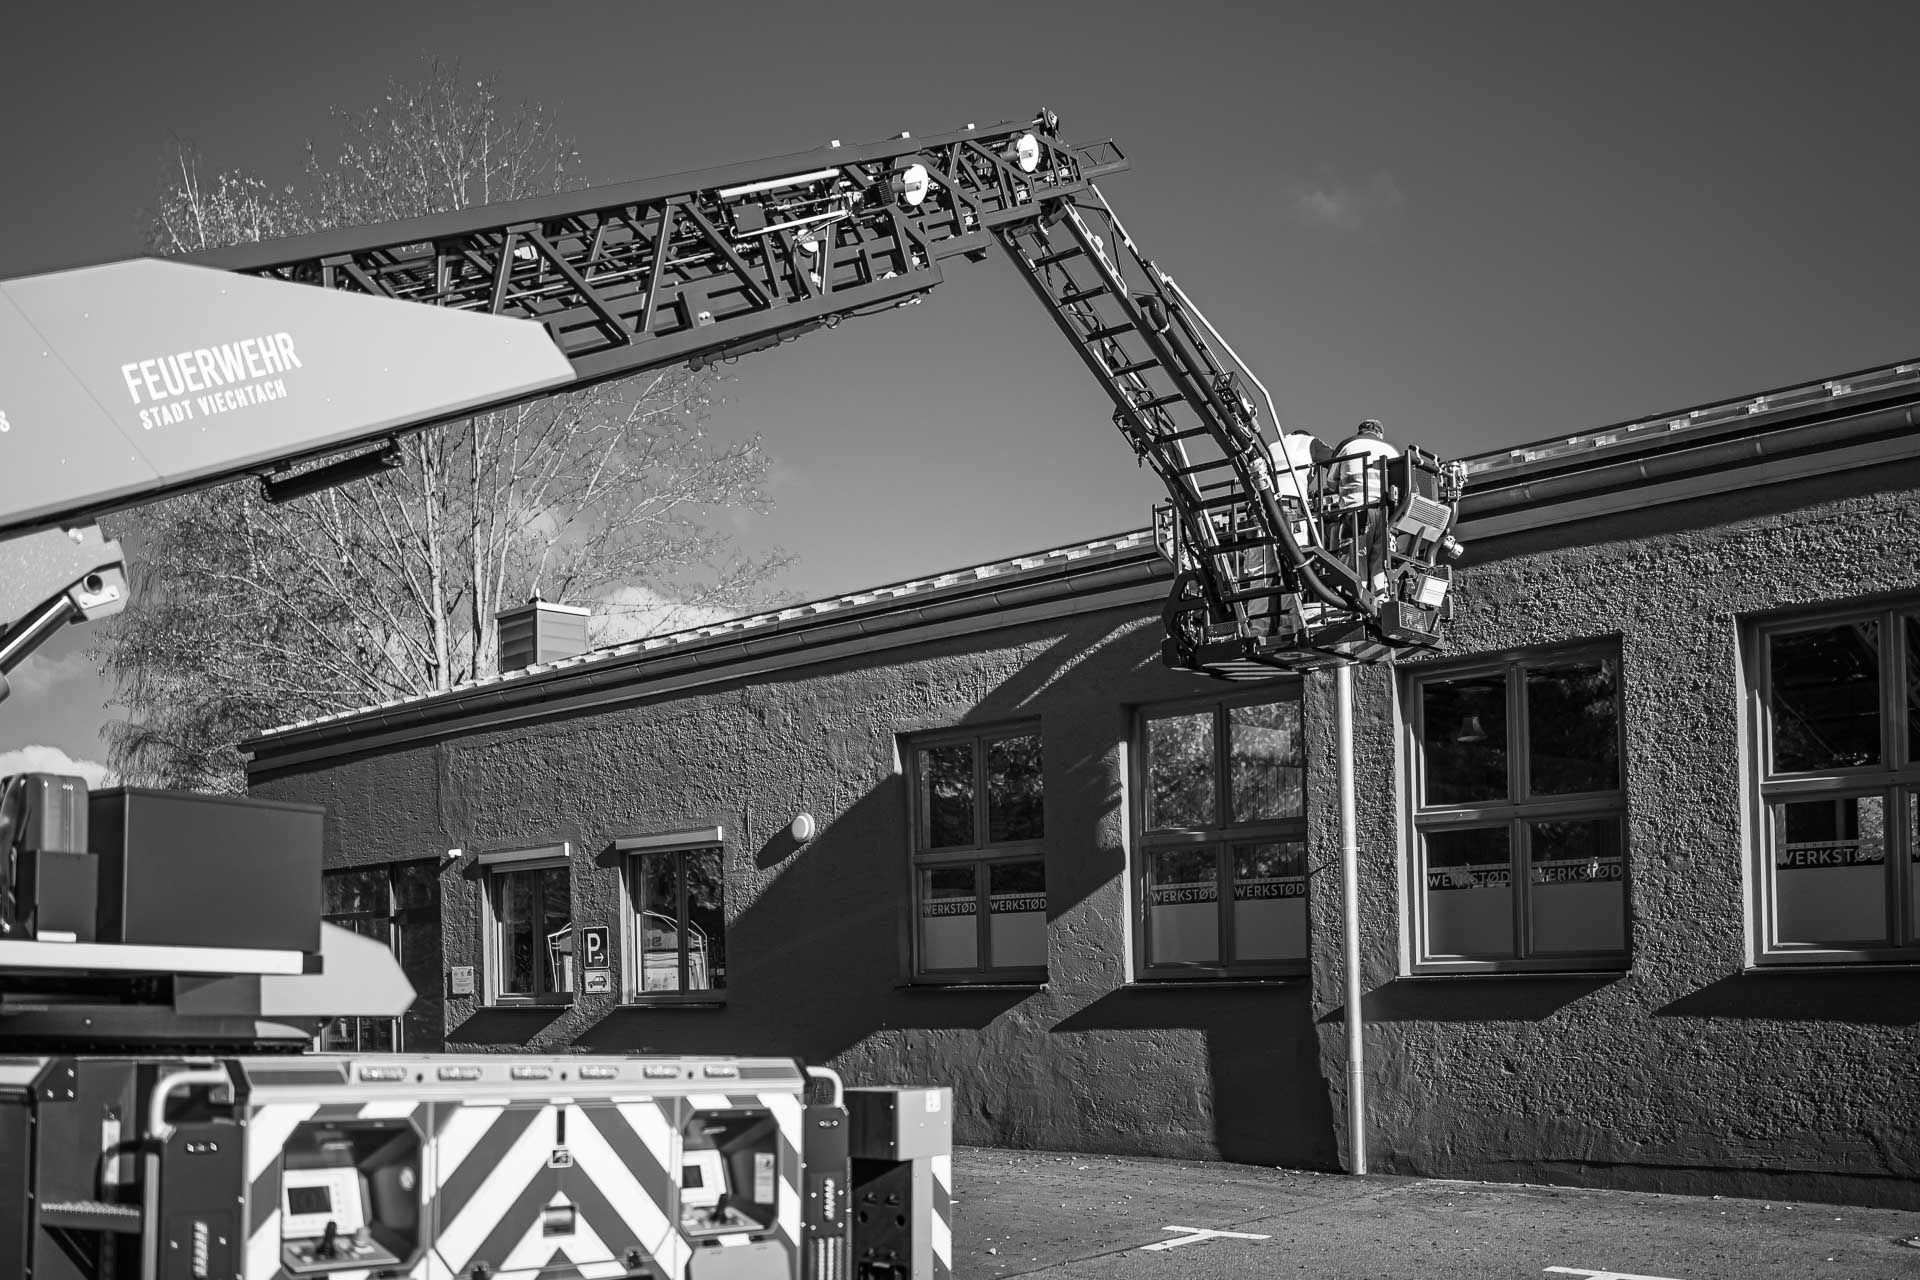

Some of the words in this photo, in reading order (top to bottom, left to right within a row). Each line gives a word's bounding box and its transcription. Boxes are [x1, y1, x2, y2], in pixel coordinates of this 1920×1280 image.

[121, 331, 303, 405] FEUERWEHR
[139, 399, 194, 431] STADT
[197, 378, 288, 417] VIECHTACH
[1778, 849, 1884, 866] ERKSTØD
[1152, 888, 1217, 903] WERKSTØD
[1234, 883, 1305, 897] WERKSTØD
[924, 902, 977, 915] WERKSTØD
[990, 898, 1047, 911] WERKSTØD
[587, 933, 600, 963] P
